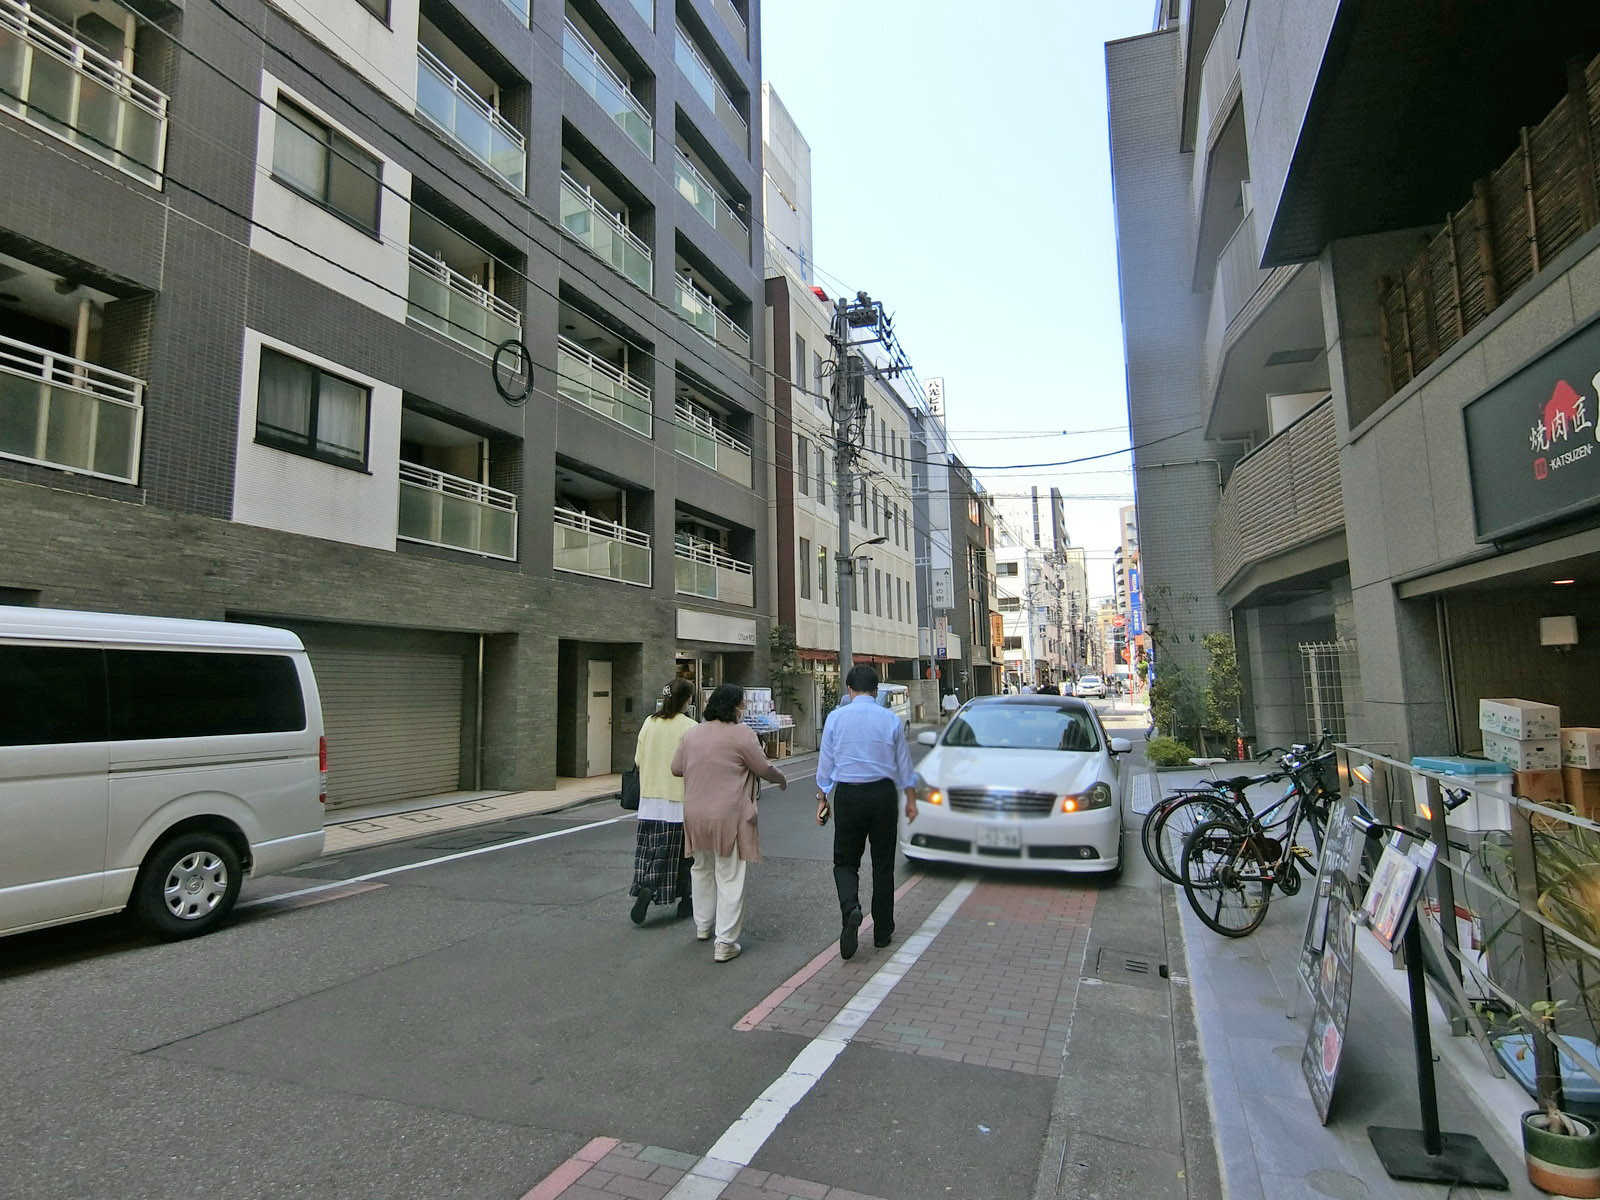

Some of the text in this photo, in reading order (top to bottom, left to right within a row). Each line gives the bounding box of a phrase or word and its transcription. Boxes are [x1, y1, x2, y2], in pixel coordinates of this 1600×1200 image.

[928, 380, 940, 412] 八光ビル
[1529, 396, 1592, 453] 焼肉匠
